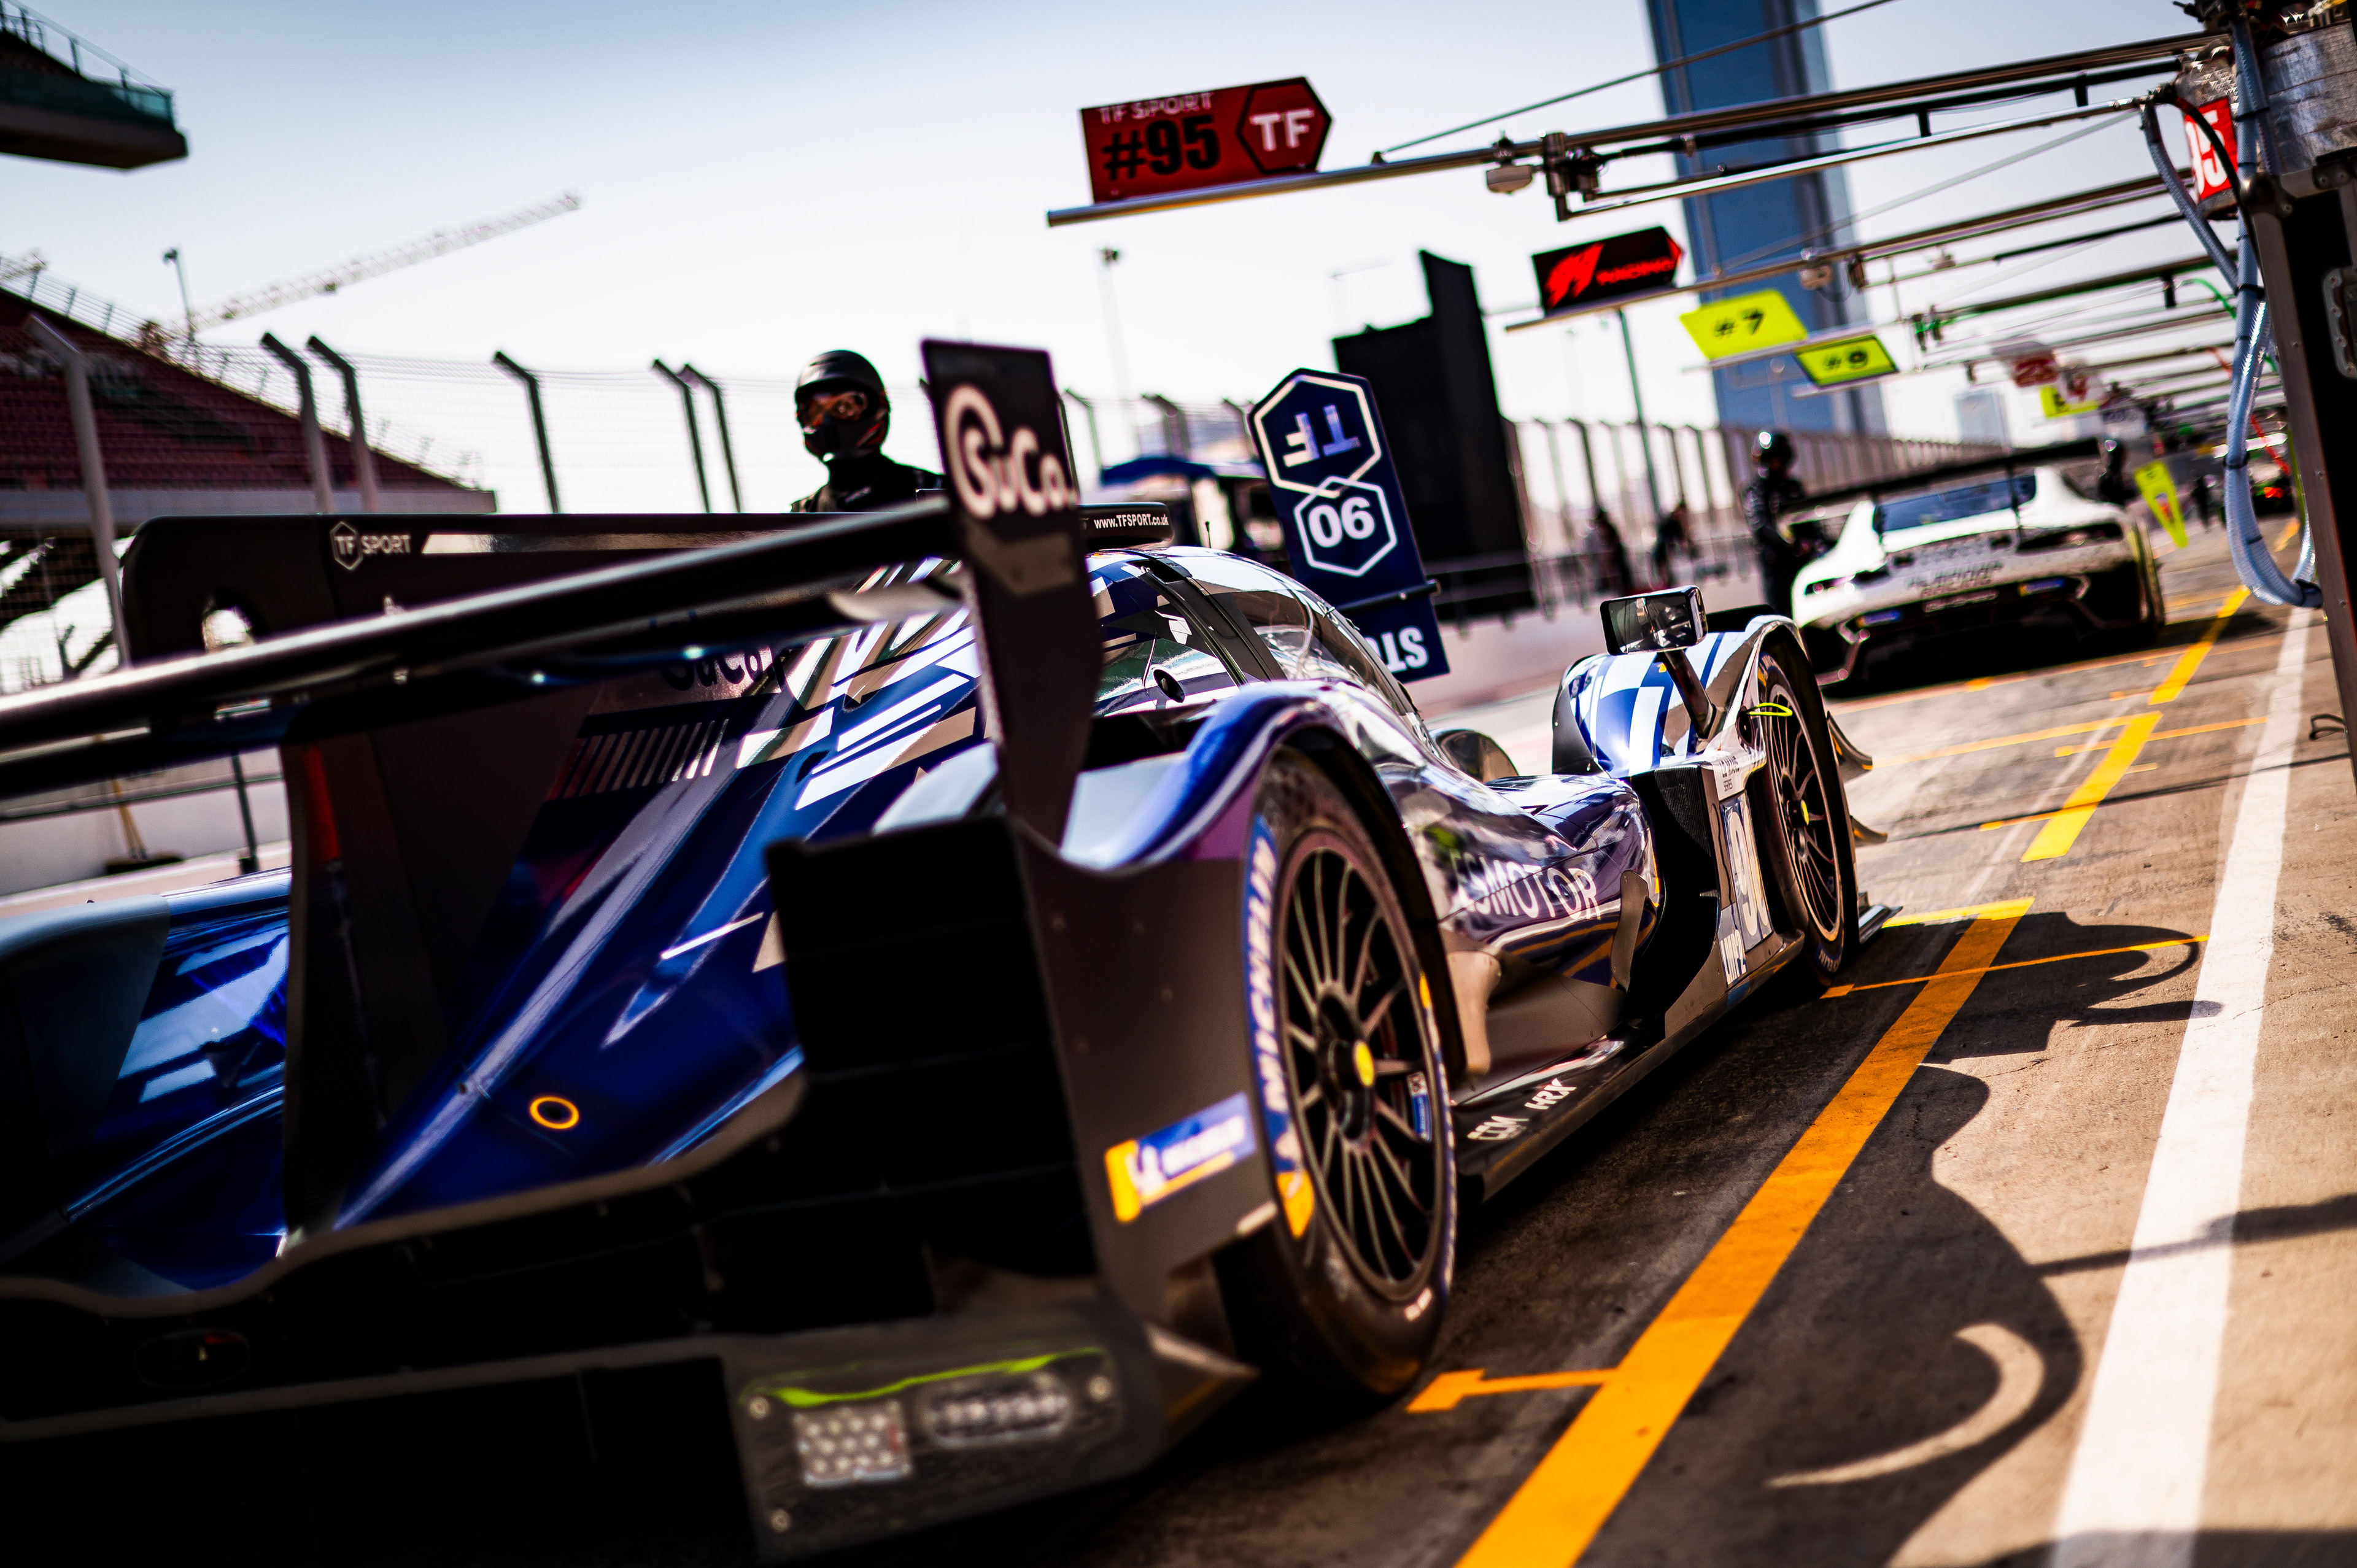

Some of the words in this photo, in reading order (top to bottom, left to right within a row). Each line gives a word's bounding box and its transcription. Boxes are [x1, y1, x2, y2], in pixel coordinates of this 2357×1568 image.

[1096, 106, 1129, 123] TF
[1131, 91, 1215, 120] SPORT
[1250, 107, 1315, 152] TF
[1102, 115, 1220, 182] #95
[1094, 513, 1169, 529] www.TFSPORT.co.uk
[335, 535, 355, 555] TF
[361, 535, 411, 554] SPORT
[1524, 1078, 1577, 1110] HRX
